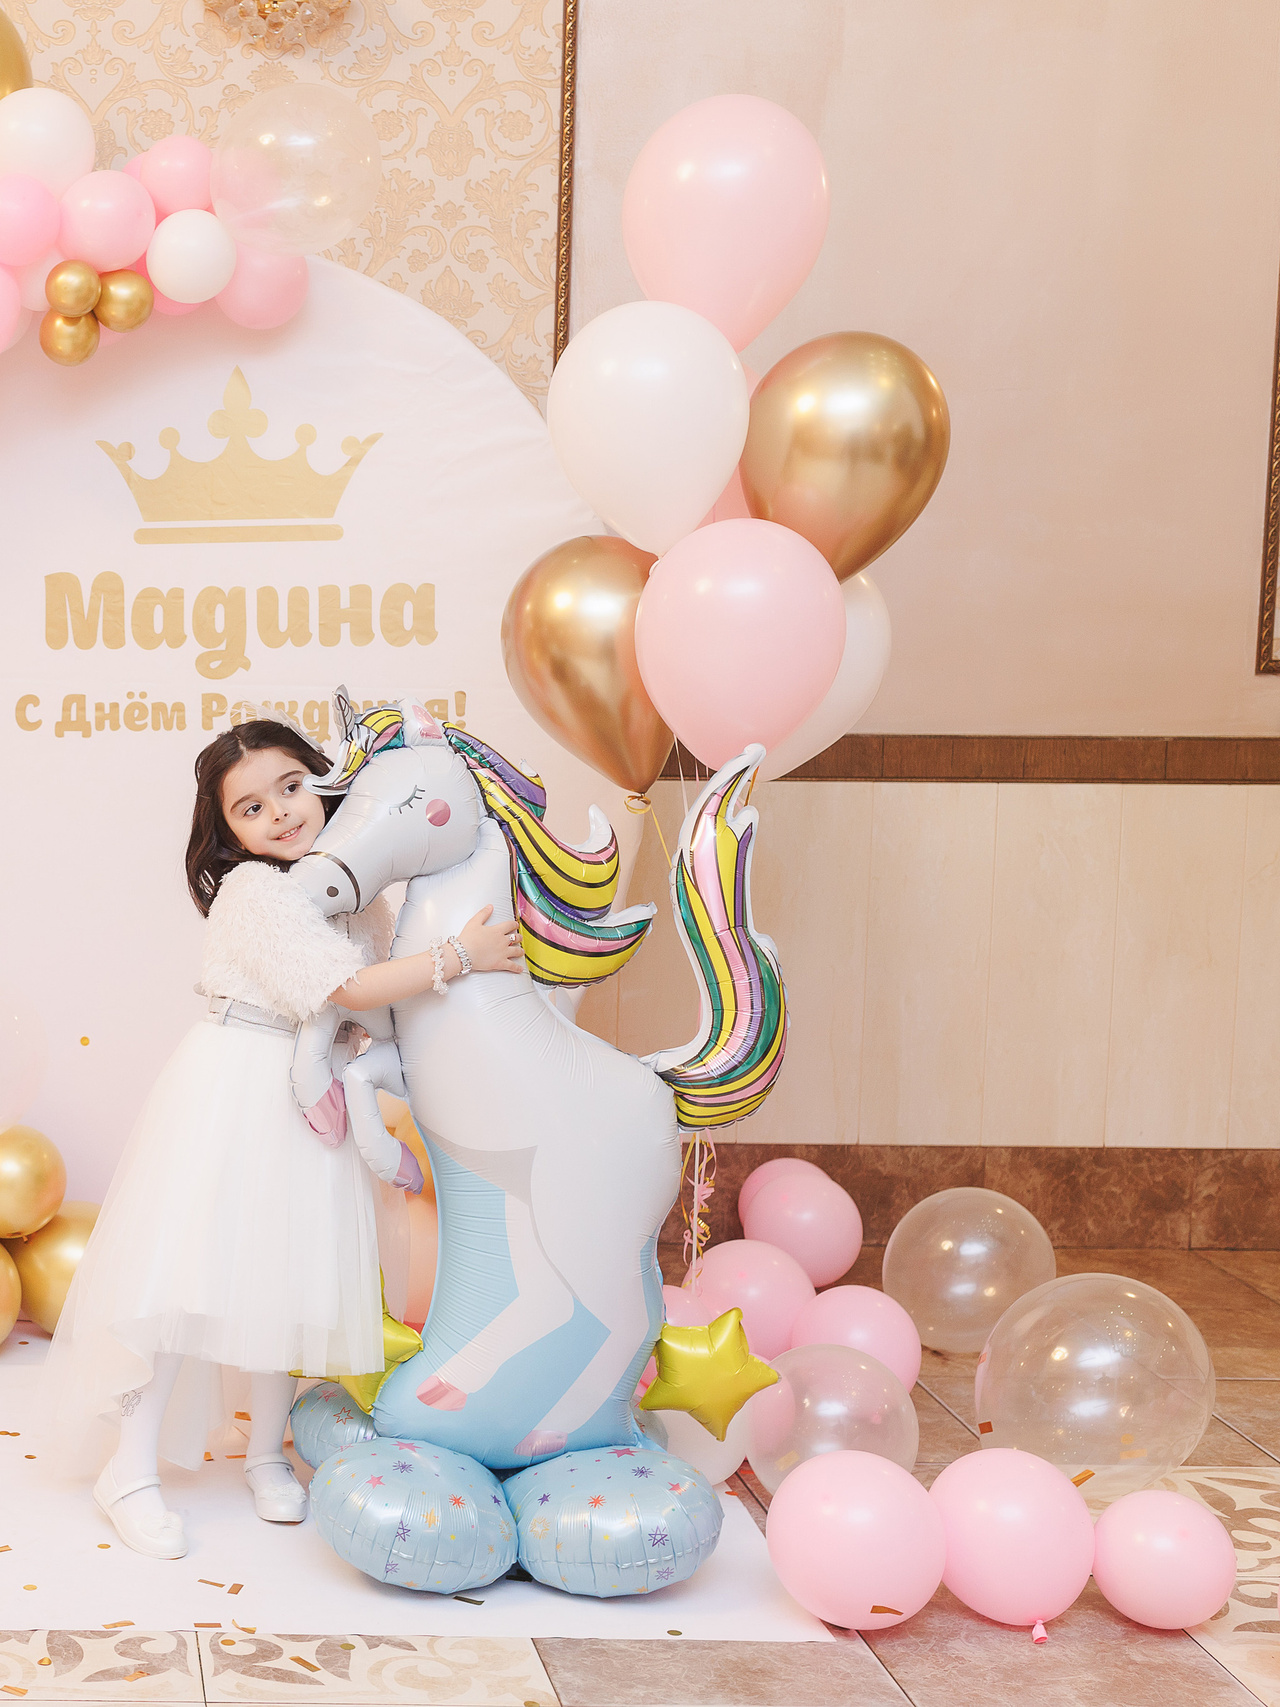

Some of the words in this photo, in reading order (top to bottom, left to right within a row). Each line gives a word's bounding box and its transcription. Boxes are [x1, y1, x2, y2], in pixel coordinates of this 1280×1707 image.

[44, 570, 439, 680] Мадина
[14, 693, 43, 732] С
[54, 690, 187, 738] Днём
